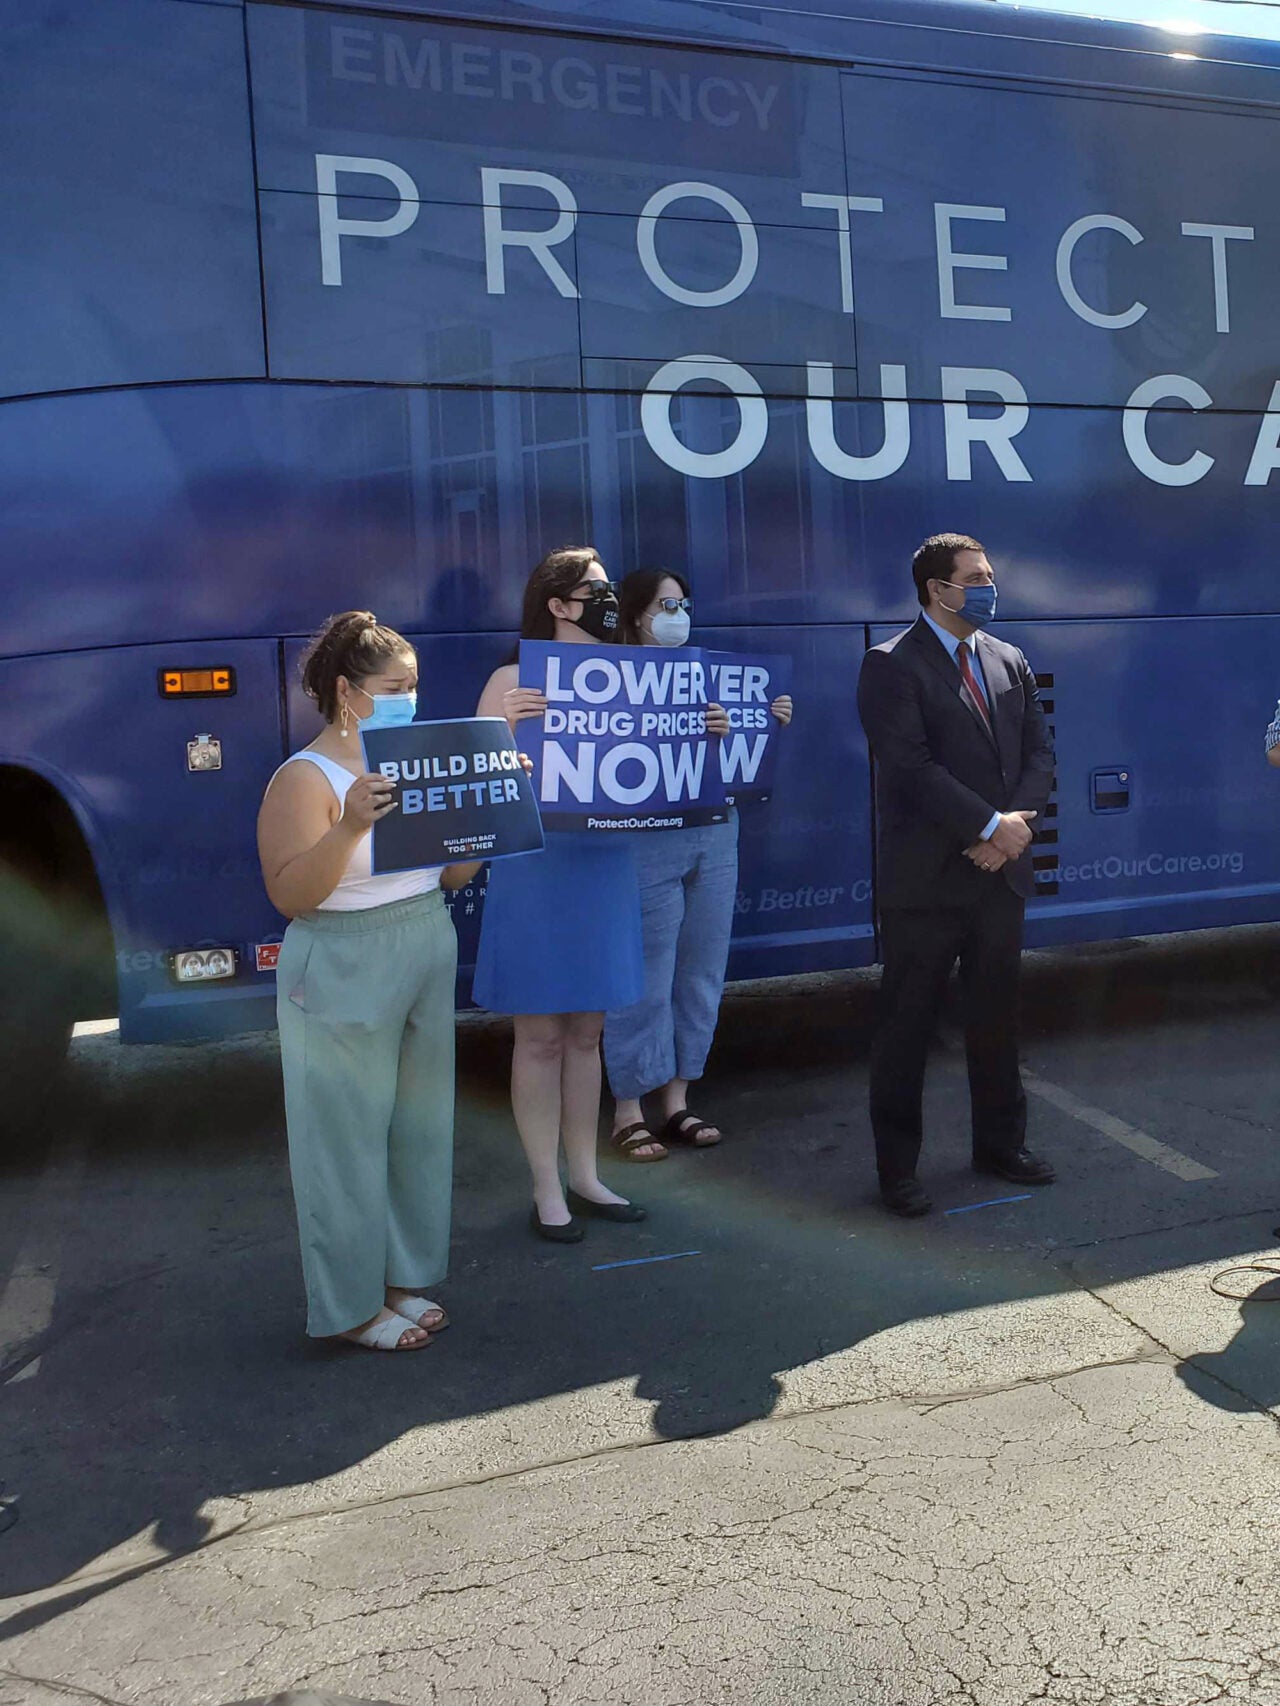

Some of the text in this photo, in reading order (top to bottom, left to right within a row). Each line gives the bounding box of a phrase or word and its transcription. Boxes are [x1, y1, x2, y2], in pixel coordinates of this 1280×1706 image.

[329, 26, 780, 132] EMERGENCY
[315, 153, 1255, 333] PROTECT
[640, 354, 1033, 481] OUR
[546, 656, 708, 706] LOWER
[543, 708, 706, 737] DRUG PRICES
[379, 750, 522, 782] BUILD BACK
[540, 740, 708, 806] NOW
[402, 778, 520, 815] BETTER
[443, 834, 497, 846] BUILDING BACK
[587, 815, 683, 832] ProtectOurCare.org
[757, 886, 844, 912] Better
